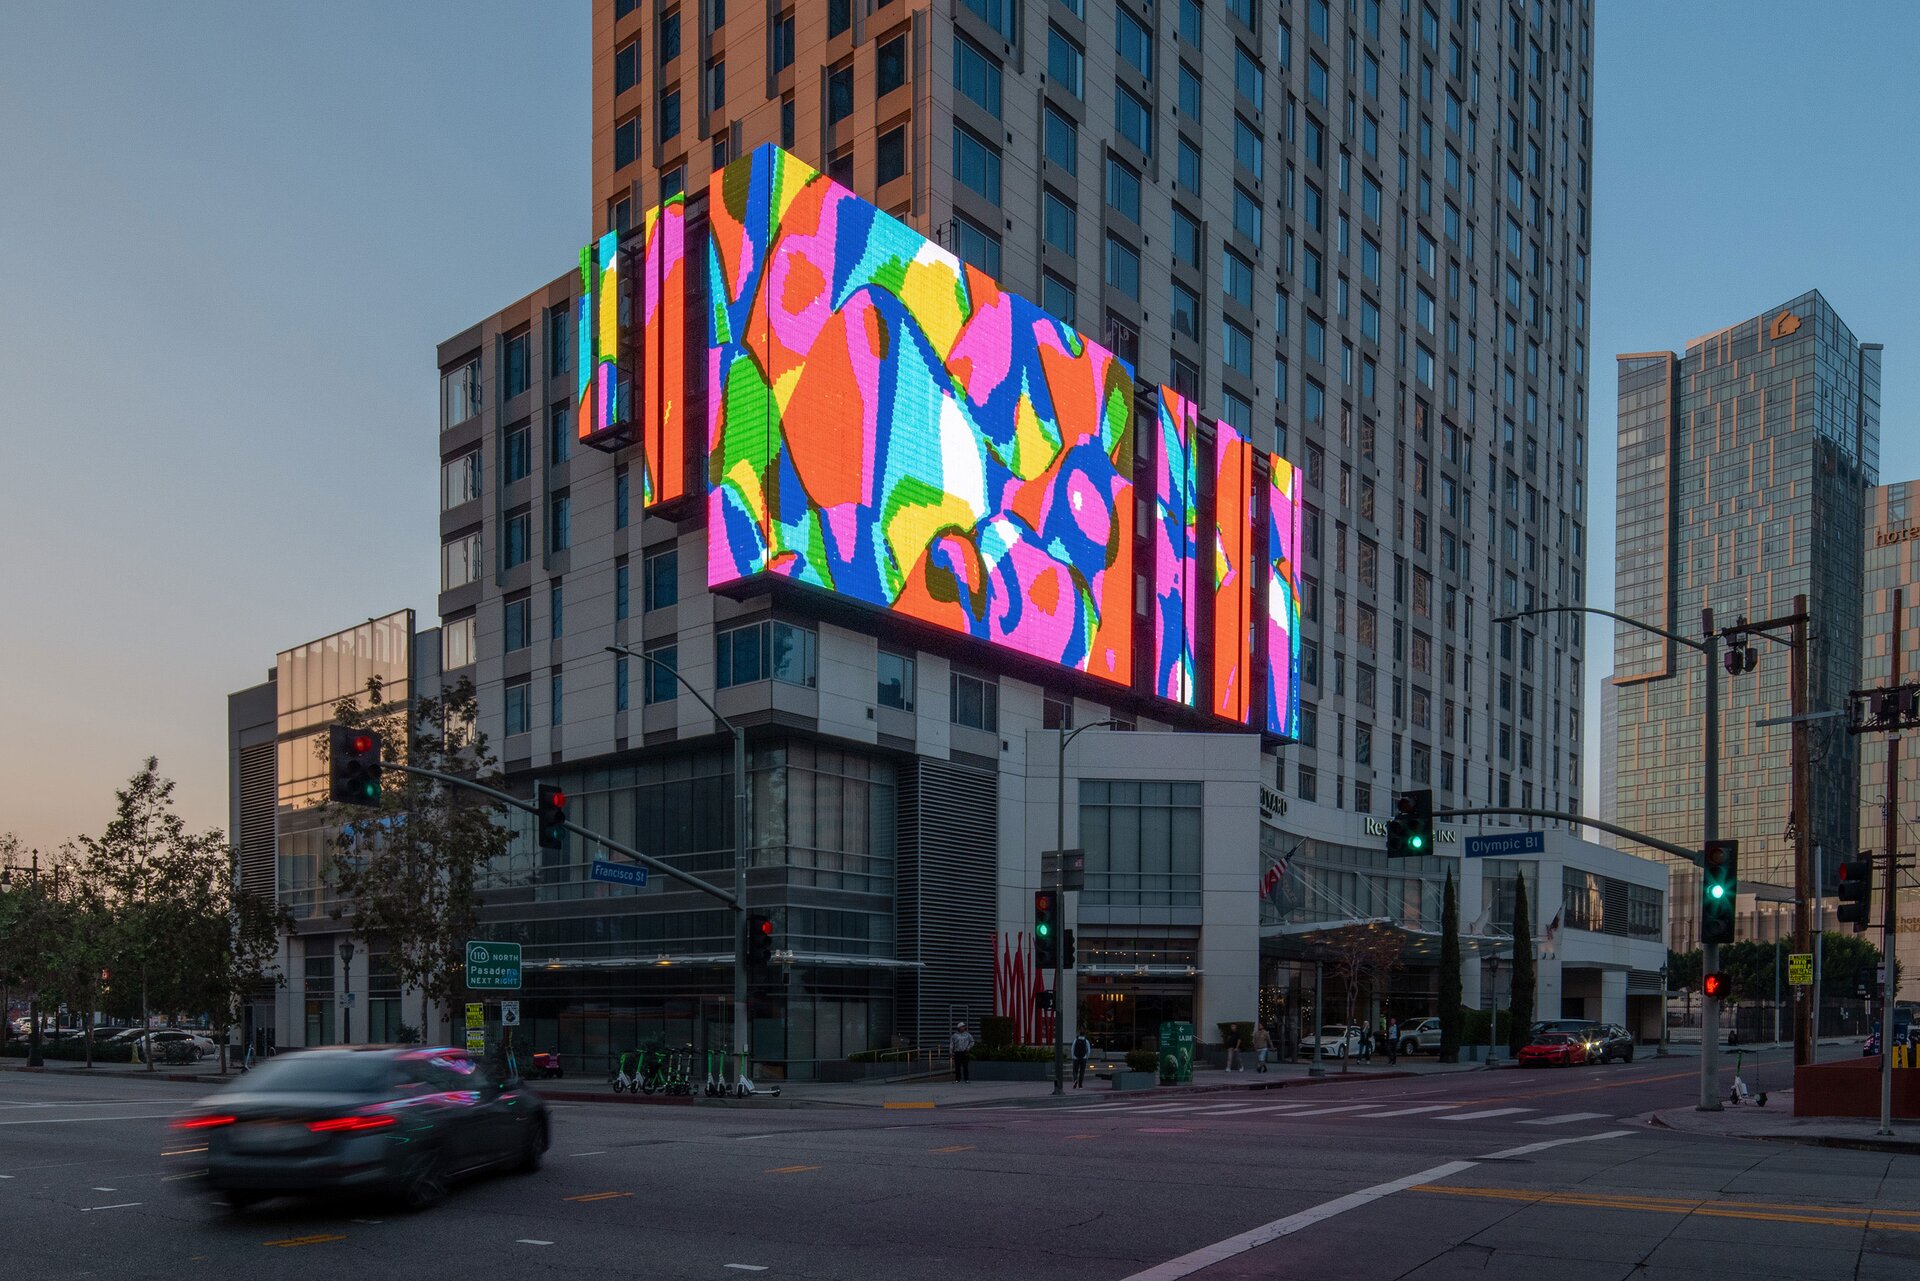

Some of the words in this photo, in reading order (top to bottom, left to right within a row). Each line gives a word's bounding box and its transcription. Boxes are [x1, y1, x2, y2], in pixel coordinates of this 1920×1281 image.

[1437, 830, 1456, 843] INN
[1471, 838, 1521, 854] Olympic
[595, 864, 634, 880] Francisco
[635, 871, 644, 882] St
[473, 952, 486, 960] 110
[470, 966, 518, 976] Pasadena
[470, 977, 491, 985] NEXT
